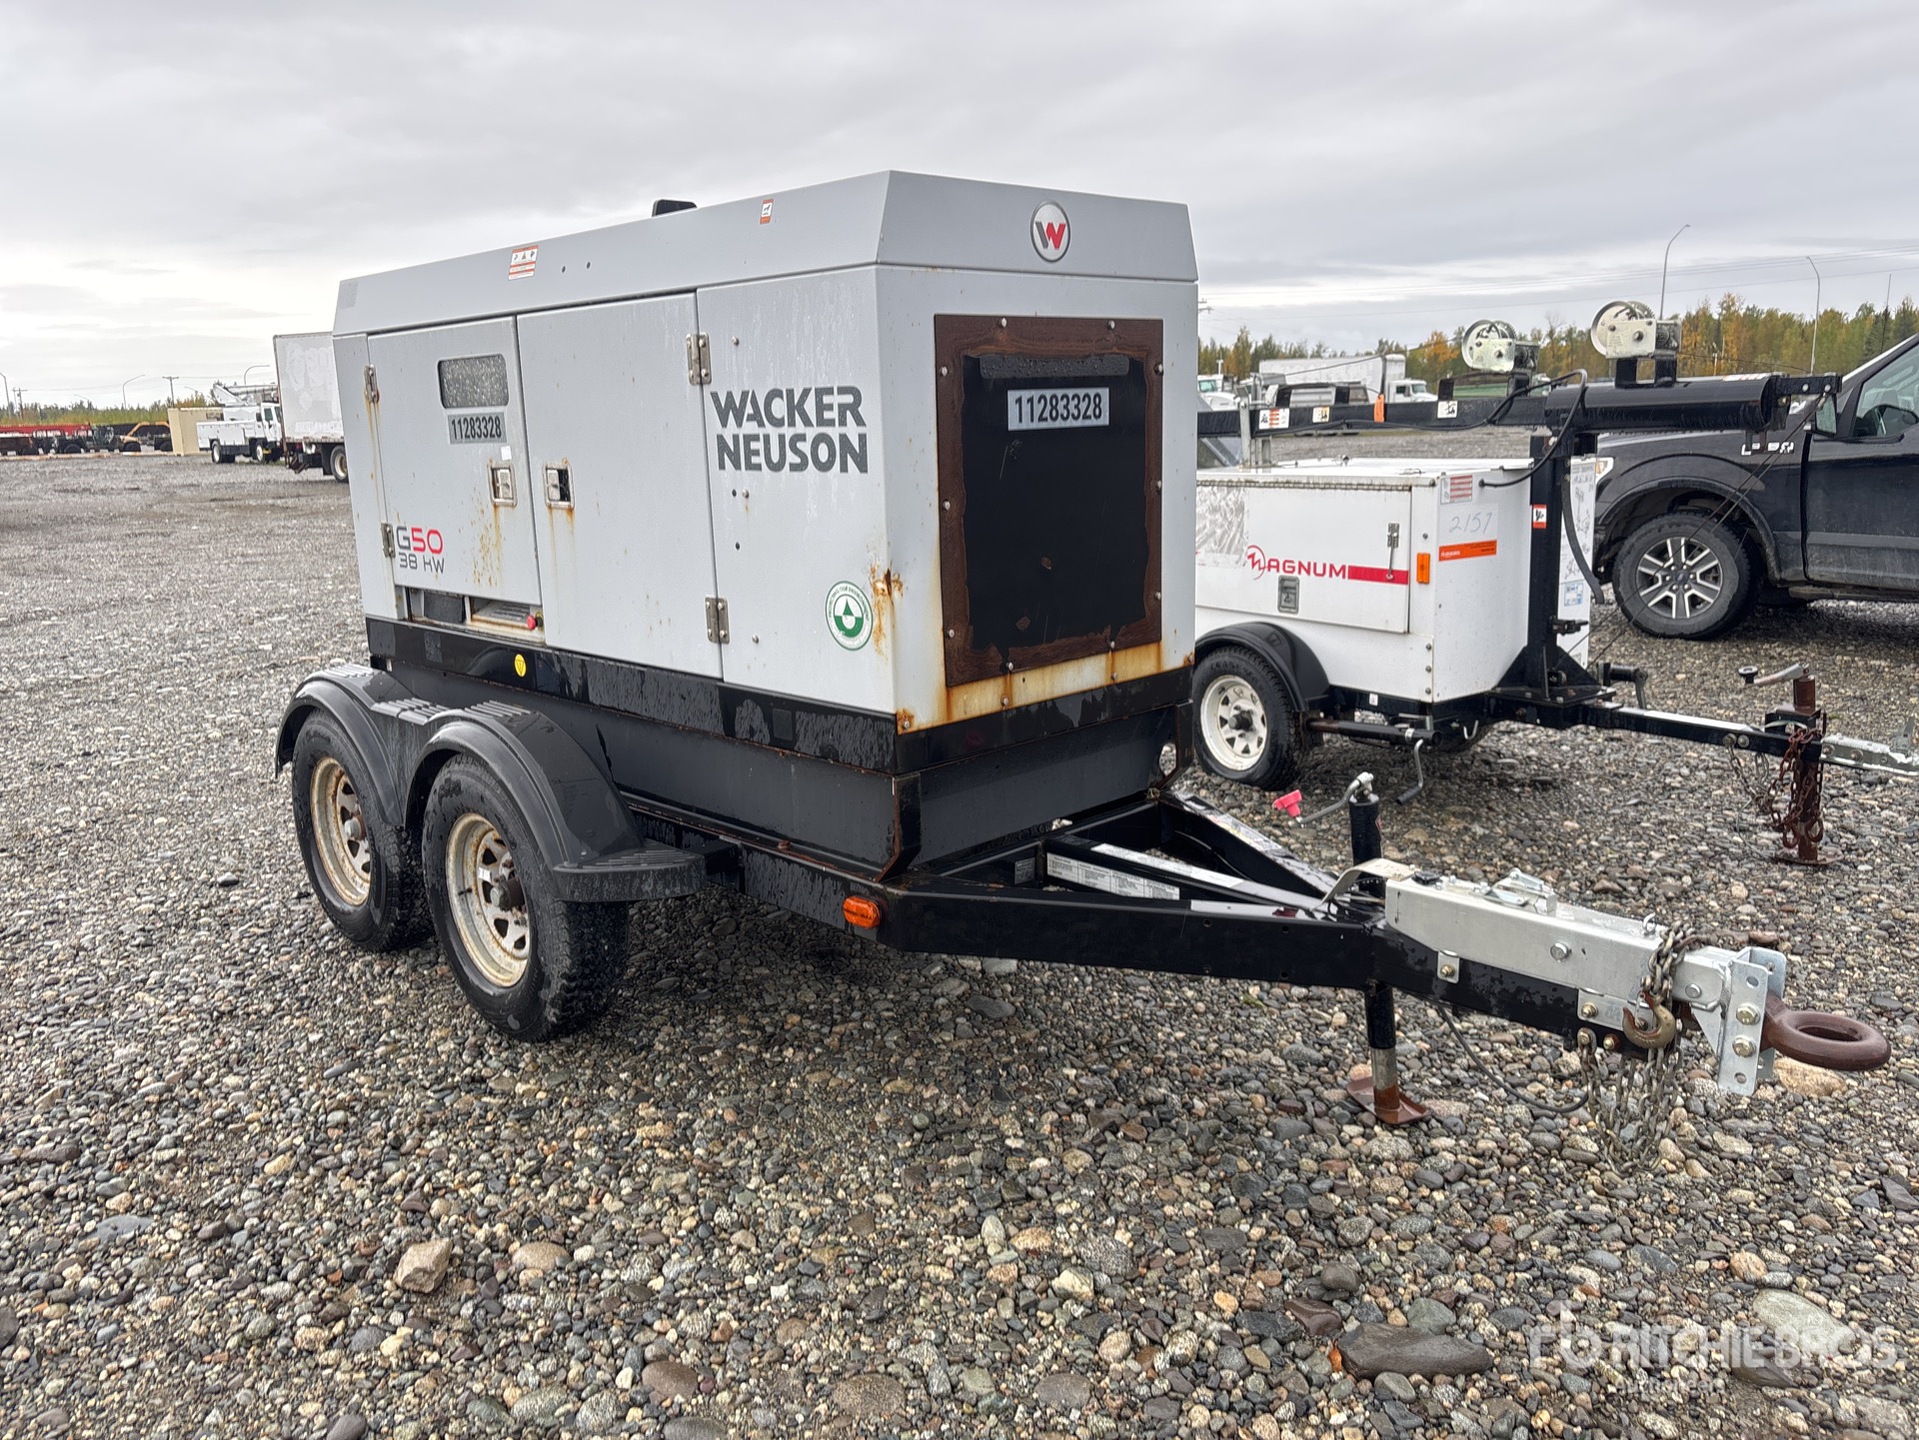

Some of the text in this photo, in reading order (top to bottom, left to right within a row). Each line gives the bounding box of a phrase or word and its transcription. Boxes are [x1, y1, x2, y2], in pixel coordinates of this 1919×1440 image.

[710, 385, 867, 428] WACKER
[1015, 392, 1102, 424] 11283328
[451, 415, 502, 440] 11283328
[716, 432, 868, 474] NEUSON
[396, 526, 444, 555] G50
[398, 552, 418, 570] 38
